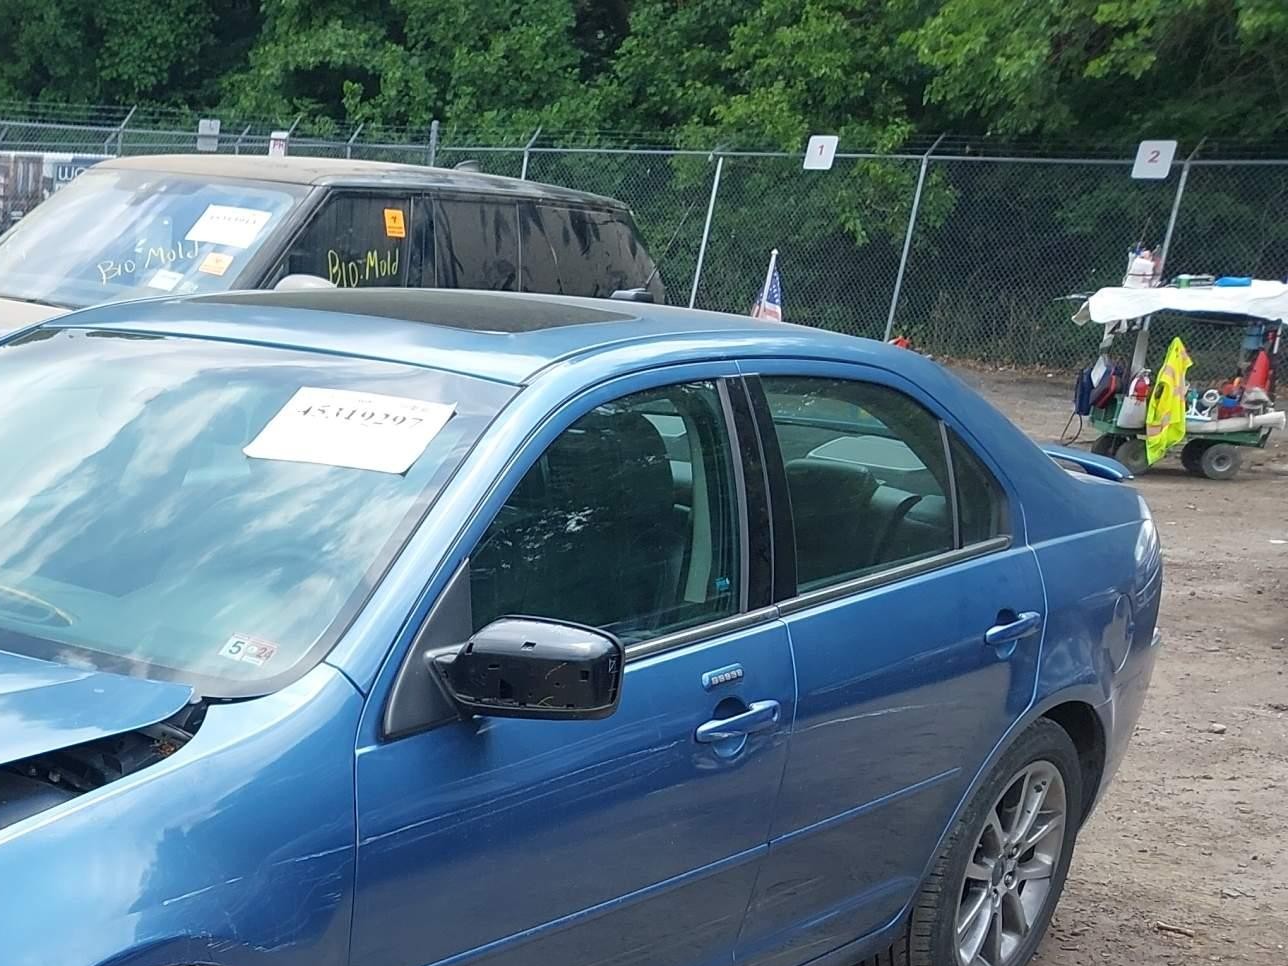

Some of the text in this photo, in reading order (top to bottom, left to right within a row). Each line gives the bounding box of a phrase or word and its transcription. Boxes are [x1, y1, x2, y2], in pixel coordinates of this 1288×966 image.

[818, 144, 825, 156] 1
[1147, 150, 1161, 163] 2
[228, 640, 246, 655] 5
